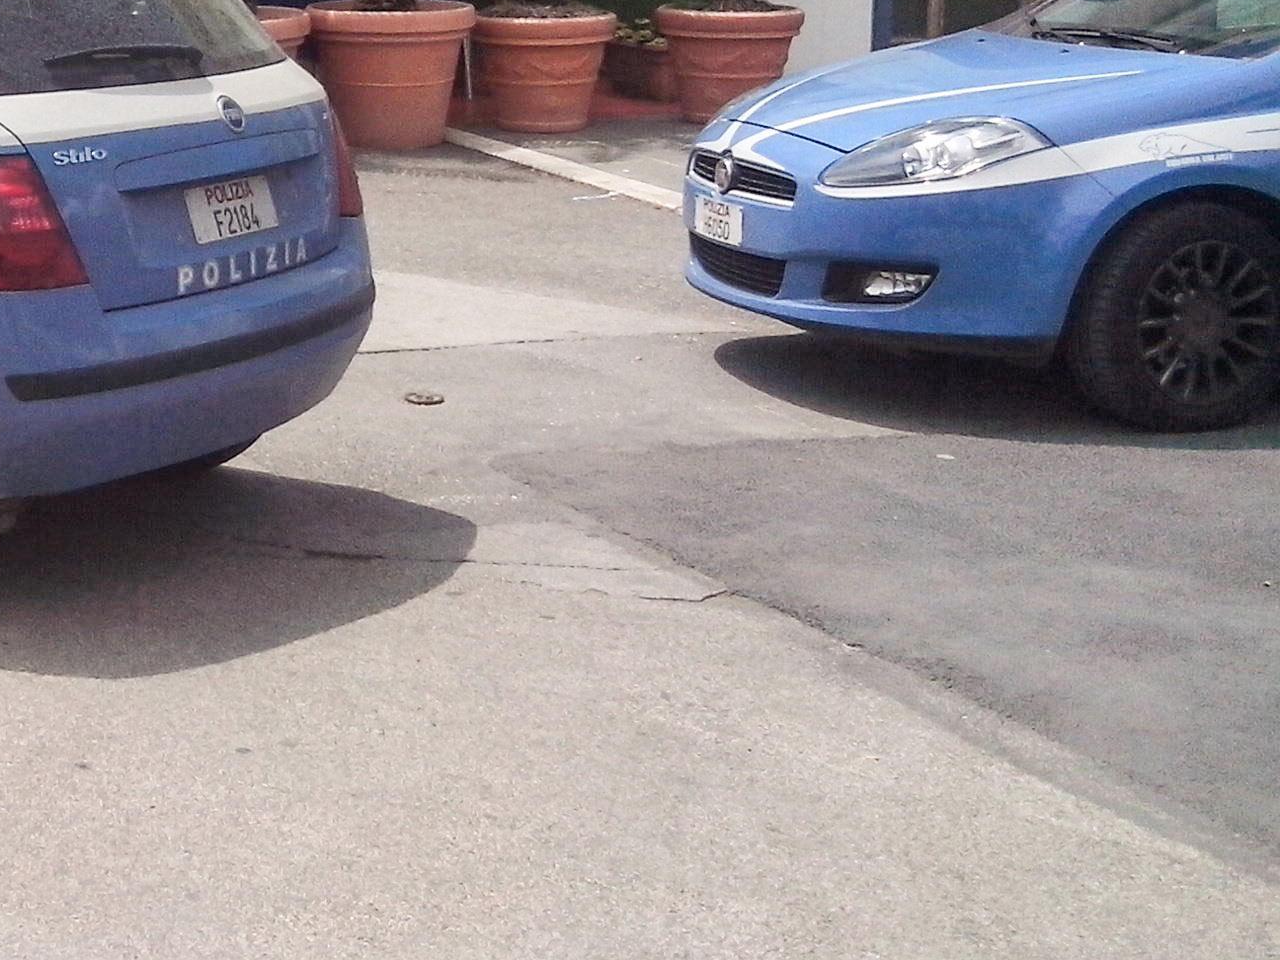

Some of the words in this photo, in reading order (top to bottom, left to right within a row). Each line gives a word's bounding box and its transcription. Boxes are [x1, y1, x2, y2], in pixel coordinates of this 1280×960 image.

[53, 146, 107, 166] Stilo
[204, 180, 254, 207] POLIZIA
[213, 202, 260, 238] F2184
[177, 237, 308, 295] POLIZIA
